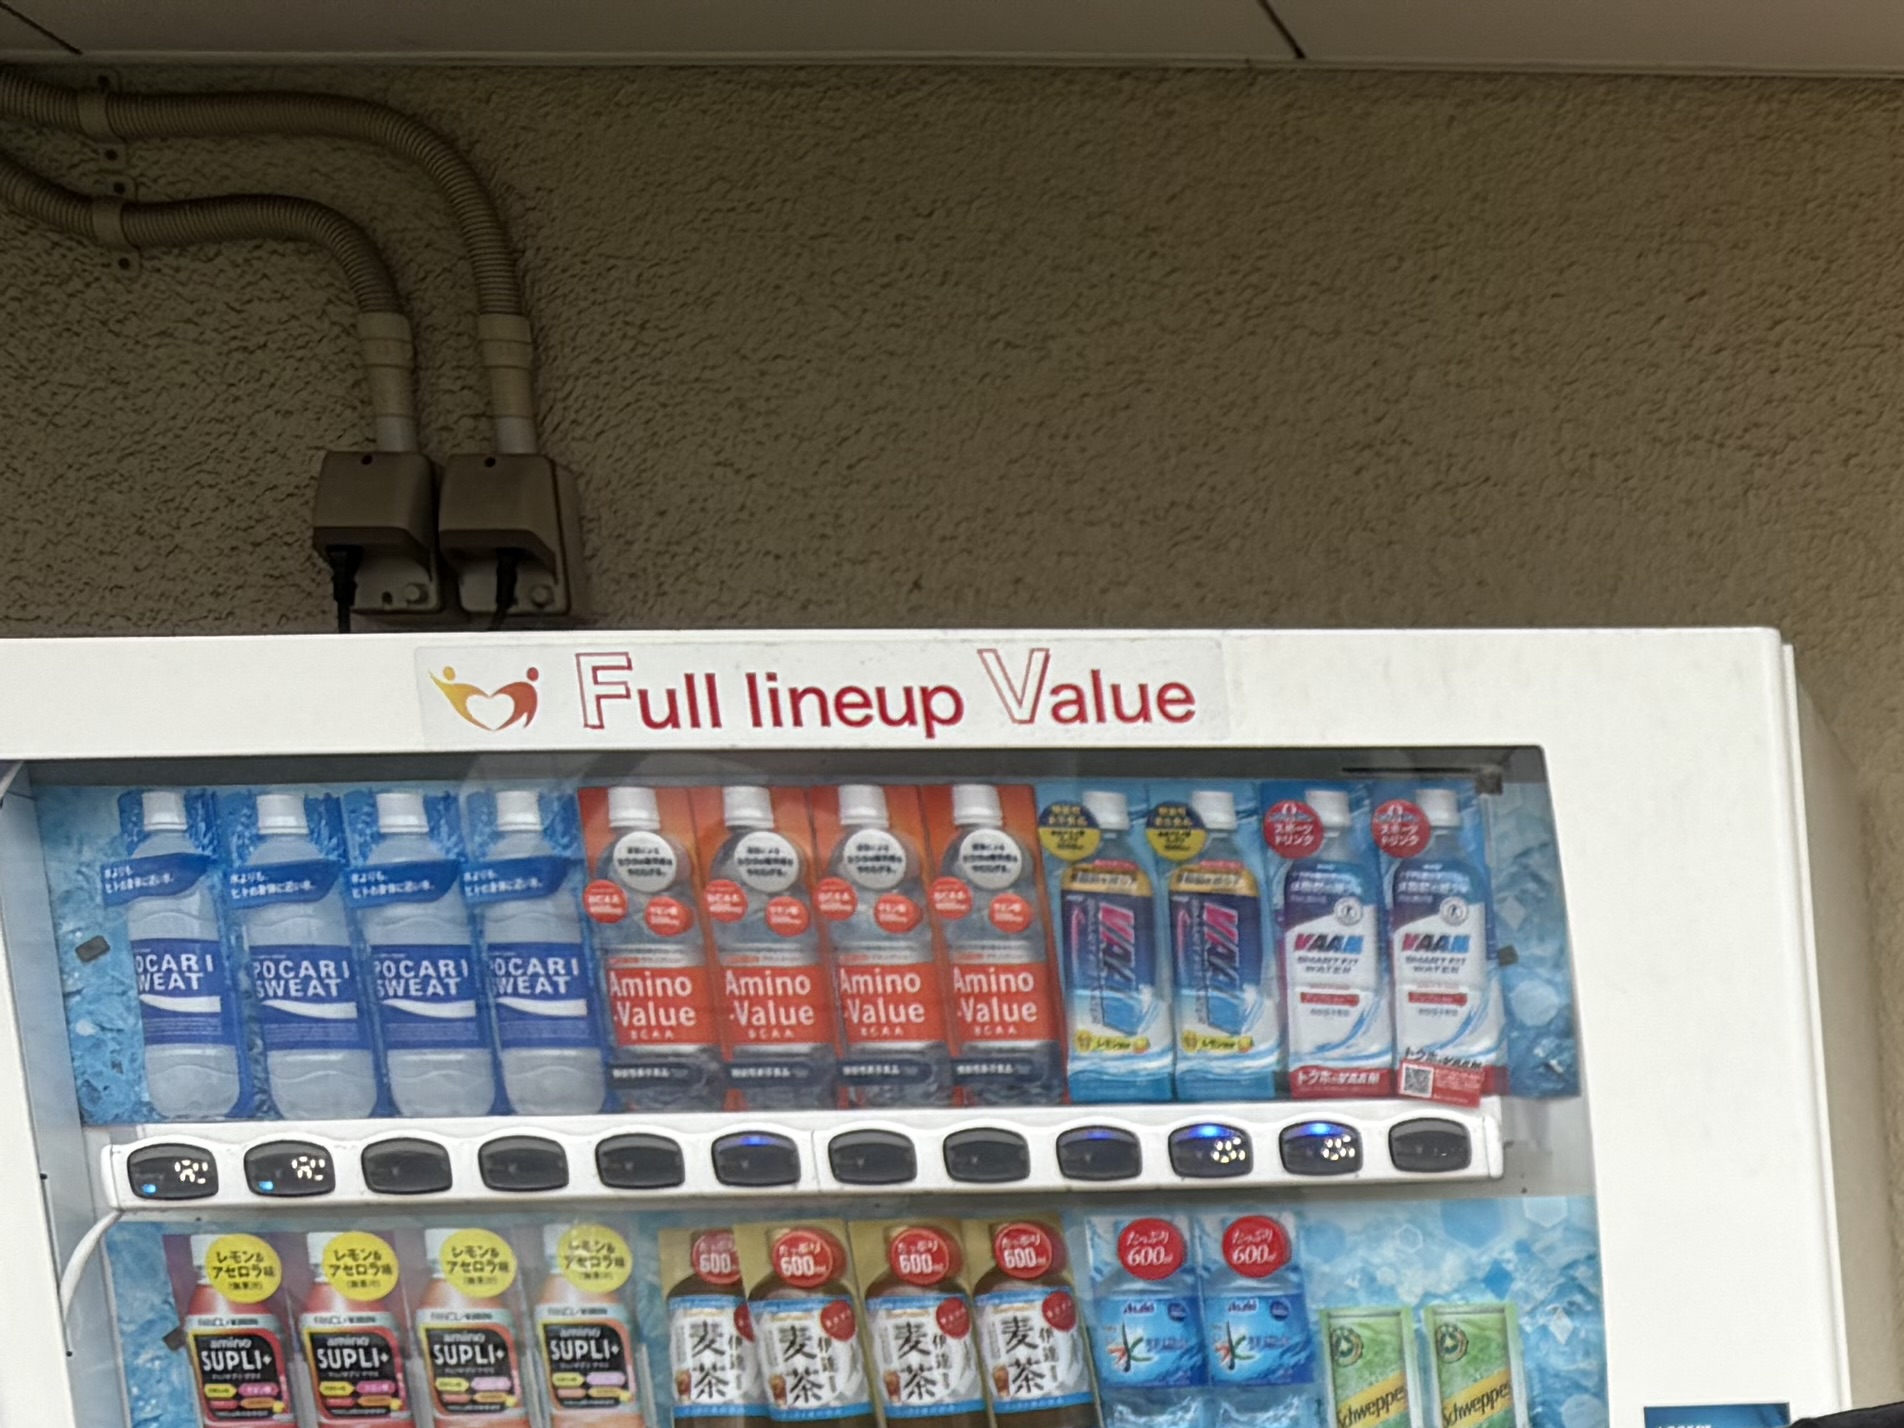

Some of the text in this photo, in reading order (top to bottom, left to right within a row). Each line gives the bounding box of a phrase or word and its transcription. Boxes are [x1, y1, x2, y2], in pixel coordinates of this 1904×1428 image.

[575, 648, 1196, 739] Full lineup Value
[610, 970, 693, 997] Amino
[726, 969, 811, 997] Amino
[840, 967, 921, 995] Amino
[954, 966, 1034, 994] Amino
[689, 1319, 730, 1399] 麦茶
[777, 1325, 826, 1405] 麦茶
[892, 1321, 936, 1400] 麦茶
[1000, 1315, 1045, 1394] 麦茶
